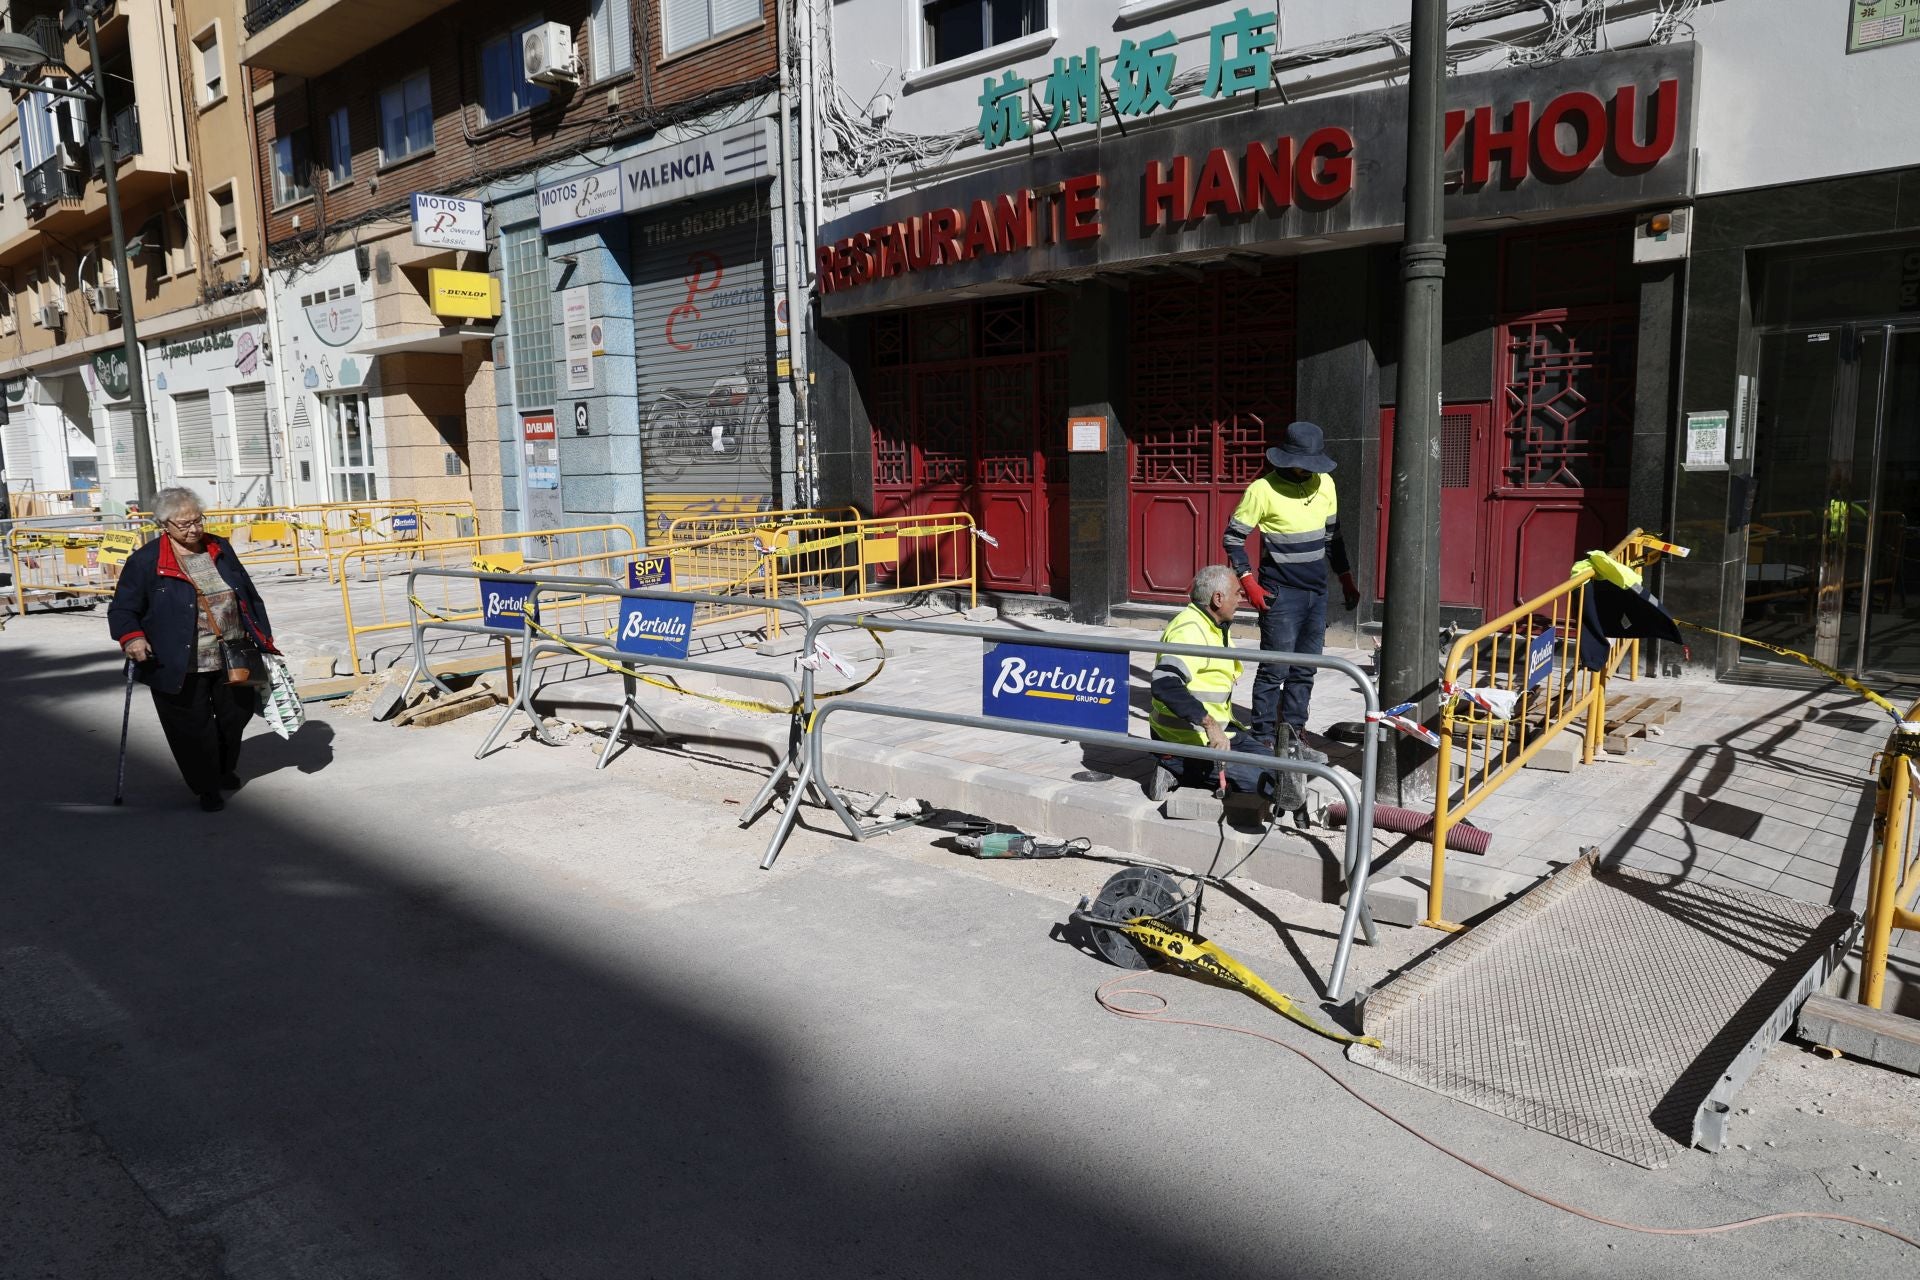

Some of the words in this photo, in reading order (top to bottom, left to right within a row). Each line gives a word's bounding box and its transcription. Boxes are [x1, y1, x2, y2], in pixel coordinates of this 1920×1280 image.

[978, 7, 1277, 150] 杭州饭店
[628, 150, 715, 193] VALENCIA
[418, 196, 466, 213] MOTOS
[541, 183, 577, 207] MOTOS
[582, 176, 618, 205] Powered
[817, 174, 1101, 295] RESTAURANTE
[1145, 126, 1354, 228] HANG
[447, 289, 487, 298] DUNLOP
[525, 422, 554, 434] DAELIM
[635, 558, 665, 577] SPV
[622, 611, 687, 641] Bertolín
[992, 657, 1116, 698] Bertolín
[1075, 695, 1099, 704] GRUPO
